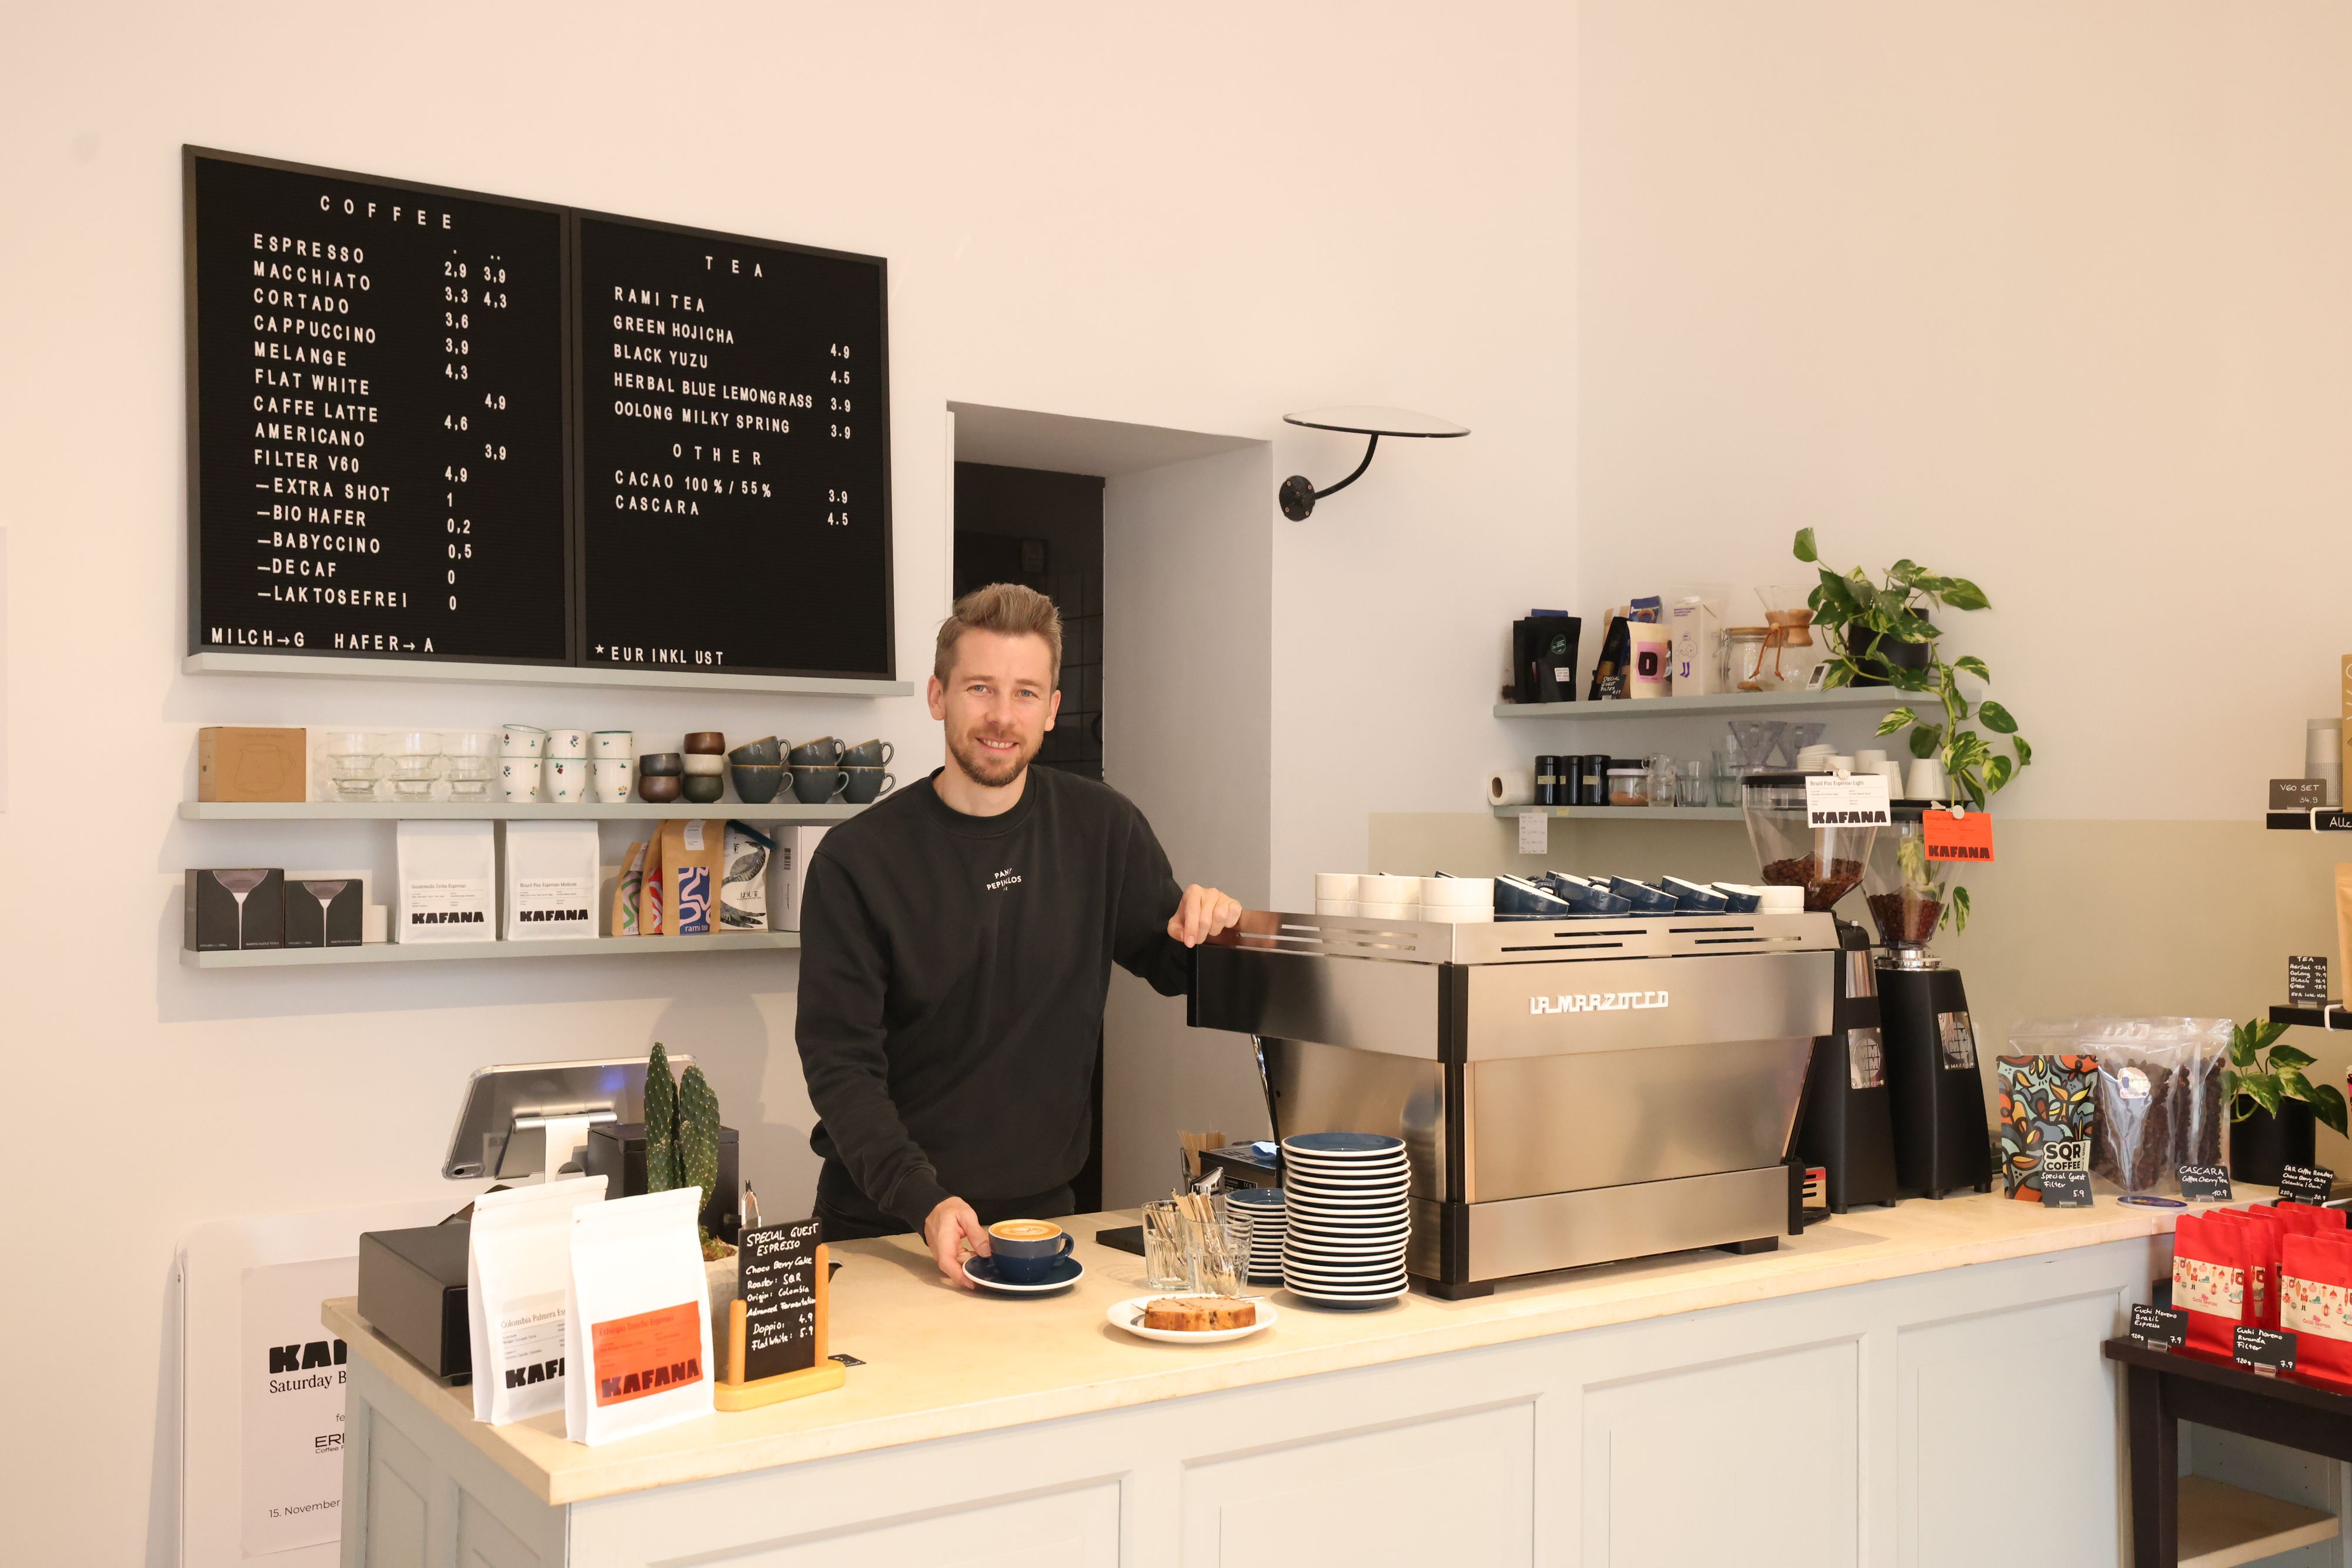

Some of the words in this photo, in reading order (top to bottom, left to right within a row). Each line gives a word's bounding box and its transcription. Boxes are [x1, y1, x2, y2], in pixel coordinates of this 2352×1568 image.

[320, 195, 451, 229] COFFEE
[254, 233, 363, 264] ESPRESSO
[445, 261, 467, 278] 2,9
[483, 266, 506, 283] 3,9
[705, 256, 763, 278] TEA
[253, 260, 370, 291] MACCHIATO
[445, 286, 468, 303] 3,3
[483, 292, 507, 309] 4,3
[253, 287, 349, 314] CORTADO
[445, 312, 469, 329] 3,6
[614, 286, 659, 306] RAMI
[671, 294, 704, 313] TEA
[254, 315, 376, 344] CAPPUCCINO
[446, 337, 469, 355] 3,9
[613, 315, 665, 335] GREEN
[672, 322, 734, 345] HOJICHA
[830, 343, 850, 359] 4.9
[254, 341, 346, 367] MELANGE
[445, 363, 468, 380] 4,3
[614, 343, 662, 363] BLACK
[669, 350, 707, 369] YUZU
[830, 370, 850, 385] 4.5
[255, 368, 302, 389] FLAT
[312, 374, 369, 396] WHITE
[485, 393, 506, 410] 4,9
[614, 372, 675, 393] HERBAL
[682, 380, 716, 397] BLUE
[723, 385, 812, 409] LEMONGRASS
[831, 397, 851, 413] 3.9
[253, 395, 314, 416] CAFFE
[325, 402, 377, 423] LATTE
[444, 414, 467, 431] 4,6
[614, 400, 673, 421] OOLONG
[682, 408, 729, 427] MILKY
[736, 414, 789, 433] SPRING
[831, 424, 851, 440] 3.9
[255, 422, 365, 447] AMERICANO
[485, 443, 506, 460] 3,9
[673, 443, 761, 466] OTHER
[254, 449, 318, 470] FILTER
[328, 455, 359, 473] V60
[445, 466, 467, 483] 4,9
[345, 483, 390, 502] SHOT
[447, 492, 452, 507] 1
[615, 470, 673, 489] CACAO
[828, 489, 848, 504] 3.9
[616, 494, 699, 516] CASCARA
[827, 512, 848, 526] 4.5
[309, 507, 366, 527] HAFER
[447, 518, 470, 534] 0,2
[448, 543, 472, 560] 0,5
[447, 569, 455, 584] 0
[449, 595, 457, 611] 0
[611, 646, 644, 662] EUR
[652, 648, 687, 664] INKL
[695, 650, 723, 665] UST
[1812, 811, 1887, 824] KAFANA
[1928, 845, 1990, 859] KAFANA
[412, 911, 484, 924] KAFANA
[520, 909, 589, 922] KAFANA
[685, 923, 701, 932] rami
[2290, 970, 2311, 978] Oolong
[1558, 991, 1669, 1013] MARZOCCO
[2046, 1144, 2081, 1161] SQR
[2046, 1161, 2080, 1170] COFFEE
[2179, 1166, 2224, 1176] CASCARA
[2069, 1172, 2086, 1182] Guest
[2182, 1175, 2197, 1183] Coffee
[2198, 1176, 2217, 1186] Cherry
[2073, 1189, 2084, 1198] 5.9
[2280, 1189, 2293, 1198] 250g
[746, 1229, 785, 1247] SPECIAL
[790, 1222, 819, 1238] GUEST
[757, 1240, 800, 1256] ESPRESSO
[746, 1265, 770, 1275] Choco
[773, 1260, 794, 1270] Berry
[794, 1256, 813, 1266] Cake
[783, 1272, 801, 1285] SQR
[778, 1285, 810, 1297] Colombia
[746, 1304, 778, 1318] Advanced
[2136, 1313, 2159, 1322] Brazil
[2155, 1309, 2177, 1318] Moreno
[501, 1316, 532, 1329] Colombia
[533, 1312, 556, 1323] Palmera
[650, 1316, 674, 1326] Espresso
[753, 1321, 785, 1336] Doppio:
[799, 1312, 814, 1324] 4.9
[2134, 1320, 2160, 1328] Espresso
[751, 1339, 769, 1352] Flat
[799, 1325, 814, 1338] 5.9
[2131, 1333, 2144, 1341] 120g
[2170, 1336, 2181, 1344] 7.9
[2238, 1335, 2266, 1345] Rwanda
[2259, 1329, 2283, 1340] Moreno
[2236, 1342, 2262, 1350] Filter
[2236, 1358, 2251, 1366] 120g
[2280, 1360, 2293, 1369] 7.9
[269, 1374, 332, 1393] Saturday
[338, 1370, 346, 1384] B
[601, 1358, 699, 1398] KAFANA
[336, 1413, 345, 1422] fe
[315, 1446, 339, 1454] Coffee
[269, 1509, 282, 1518] 15.
[285, 1500, 341, 1516] November
